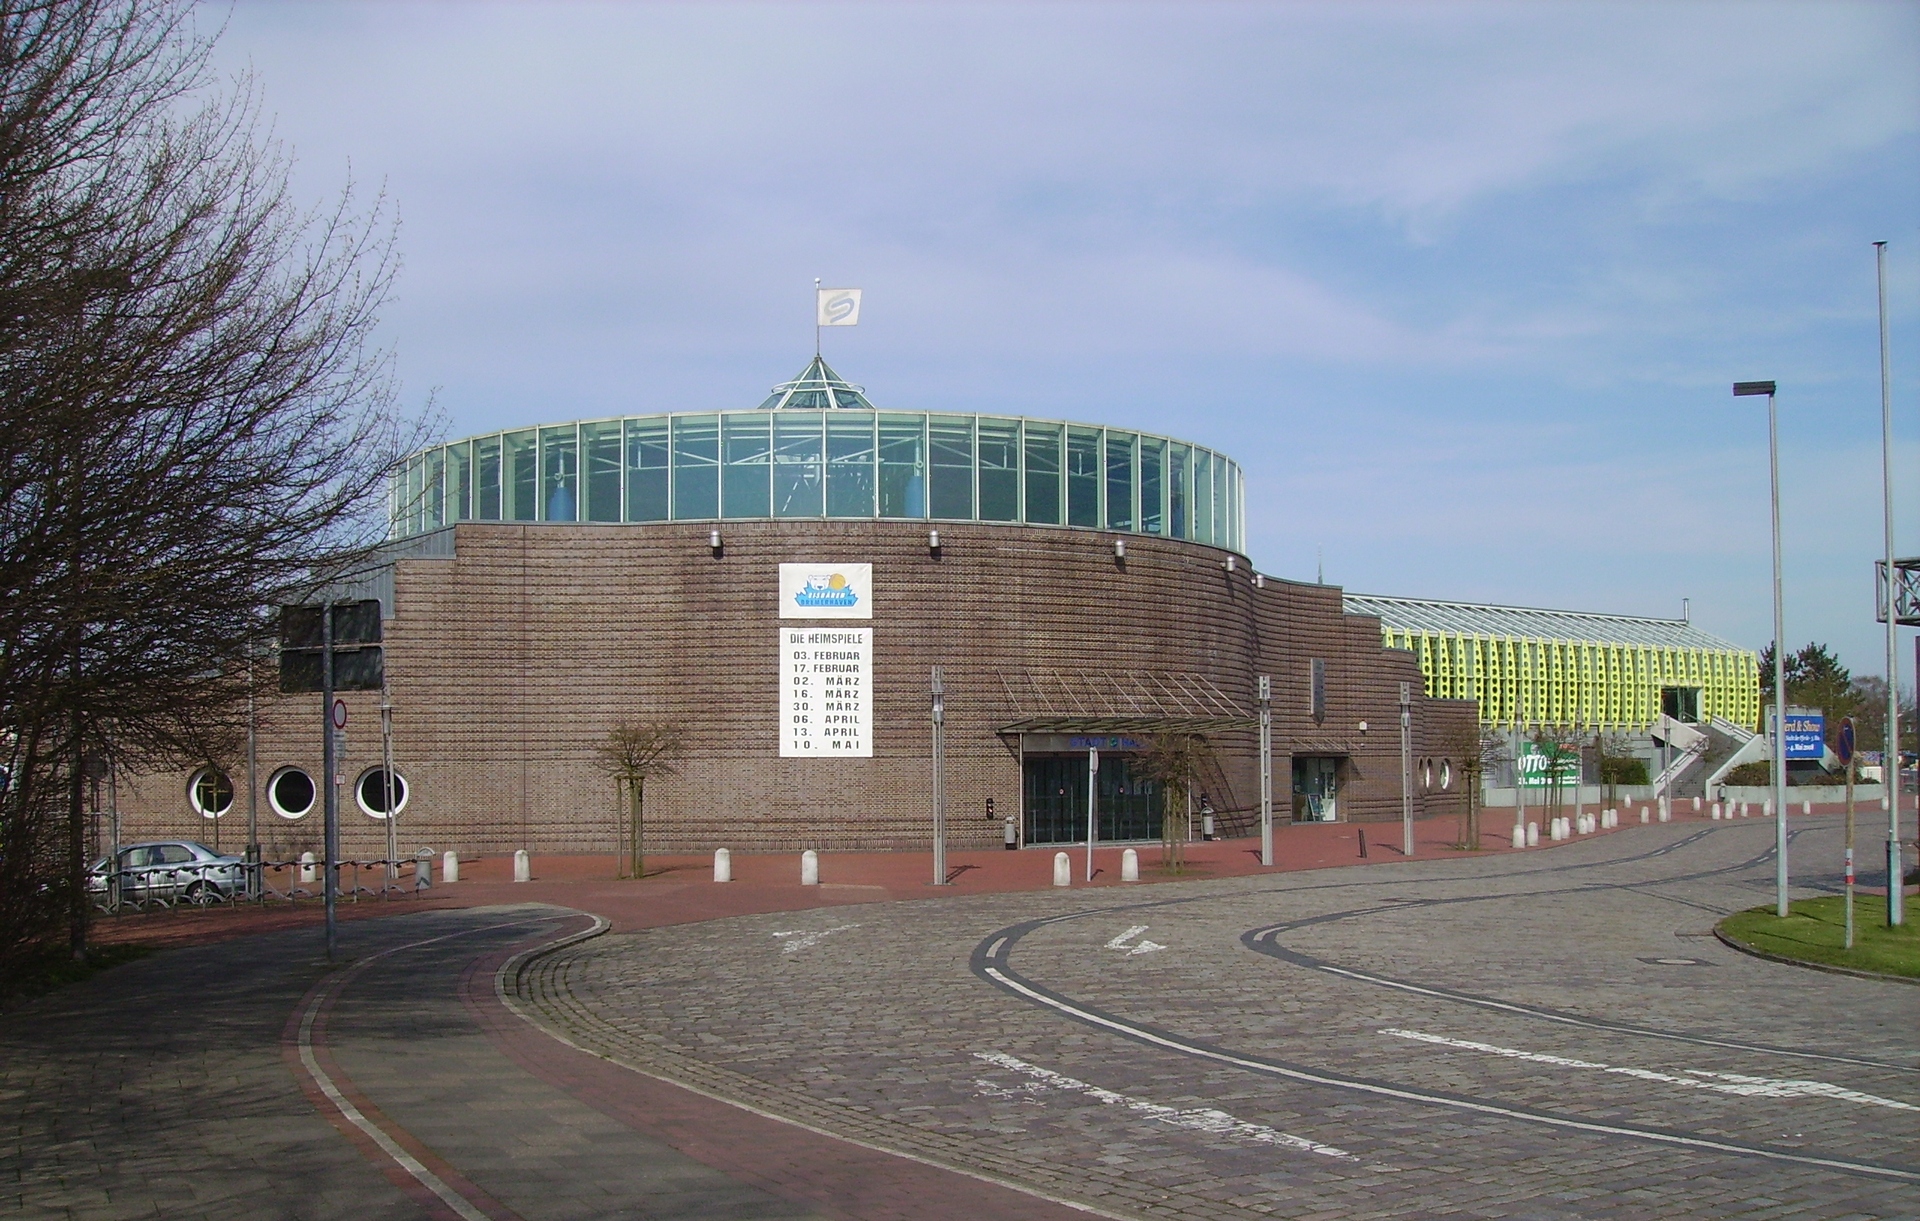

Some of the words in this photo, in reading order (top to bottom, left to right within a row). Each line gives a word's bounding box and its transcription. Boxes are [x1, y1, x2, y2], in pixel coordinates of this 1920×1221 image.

[790, 633, 805, 644] DIE
[808, 633, 863, 644] HEIMSPIELE
[793, 651, 811, 660] 03.
[814, 651, 860, 660] FEBRUAR
[793, 664, 810, 673] 17.
[813, 664, 859, 673] FEBRUAR
[793, 676, 814, 686] 02.
[825, 674, 860, 686] MÄRZ
[793, 689, 813, 699] 16.
[825, 687, 859, 699] MÄRZ
[793, 702, 814, 711] 30.
[825, 700, 860, 711] MÄRZ
[793, 715, 813, 724] 06.
[824, 715, 860, 724] APRIL
[793, 728, 812, 737] 13.
[824, 728, 859, 737] APRIL
[793, 740, 818, 750] 10.
[832, 740, 859, 750] MAI
[1070, 737, 1106, 747] STADT
[1518, 754, 1547, 773] OTTO
